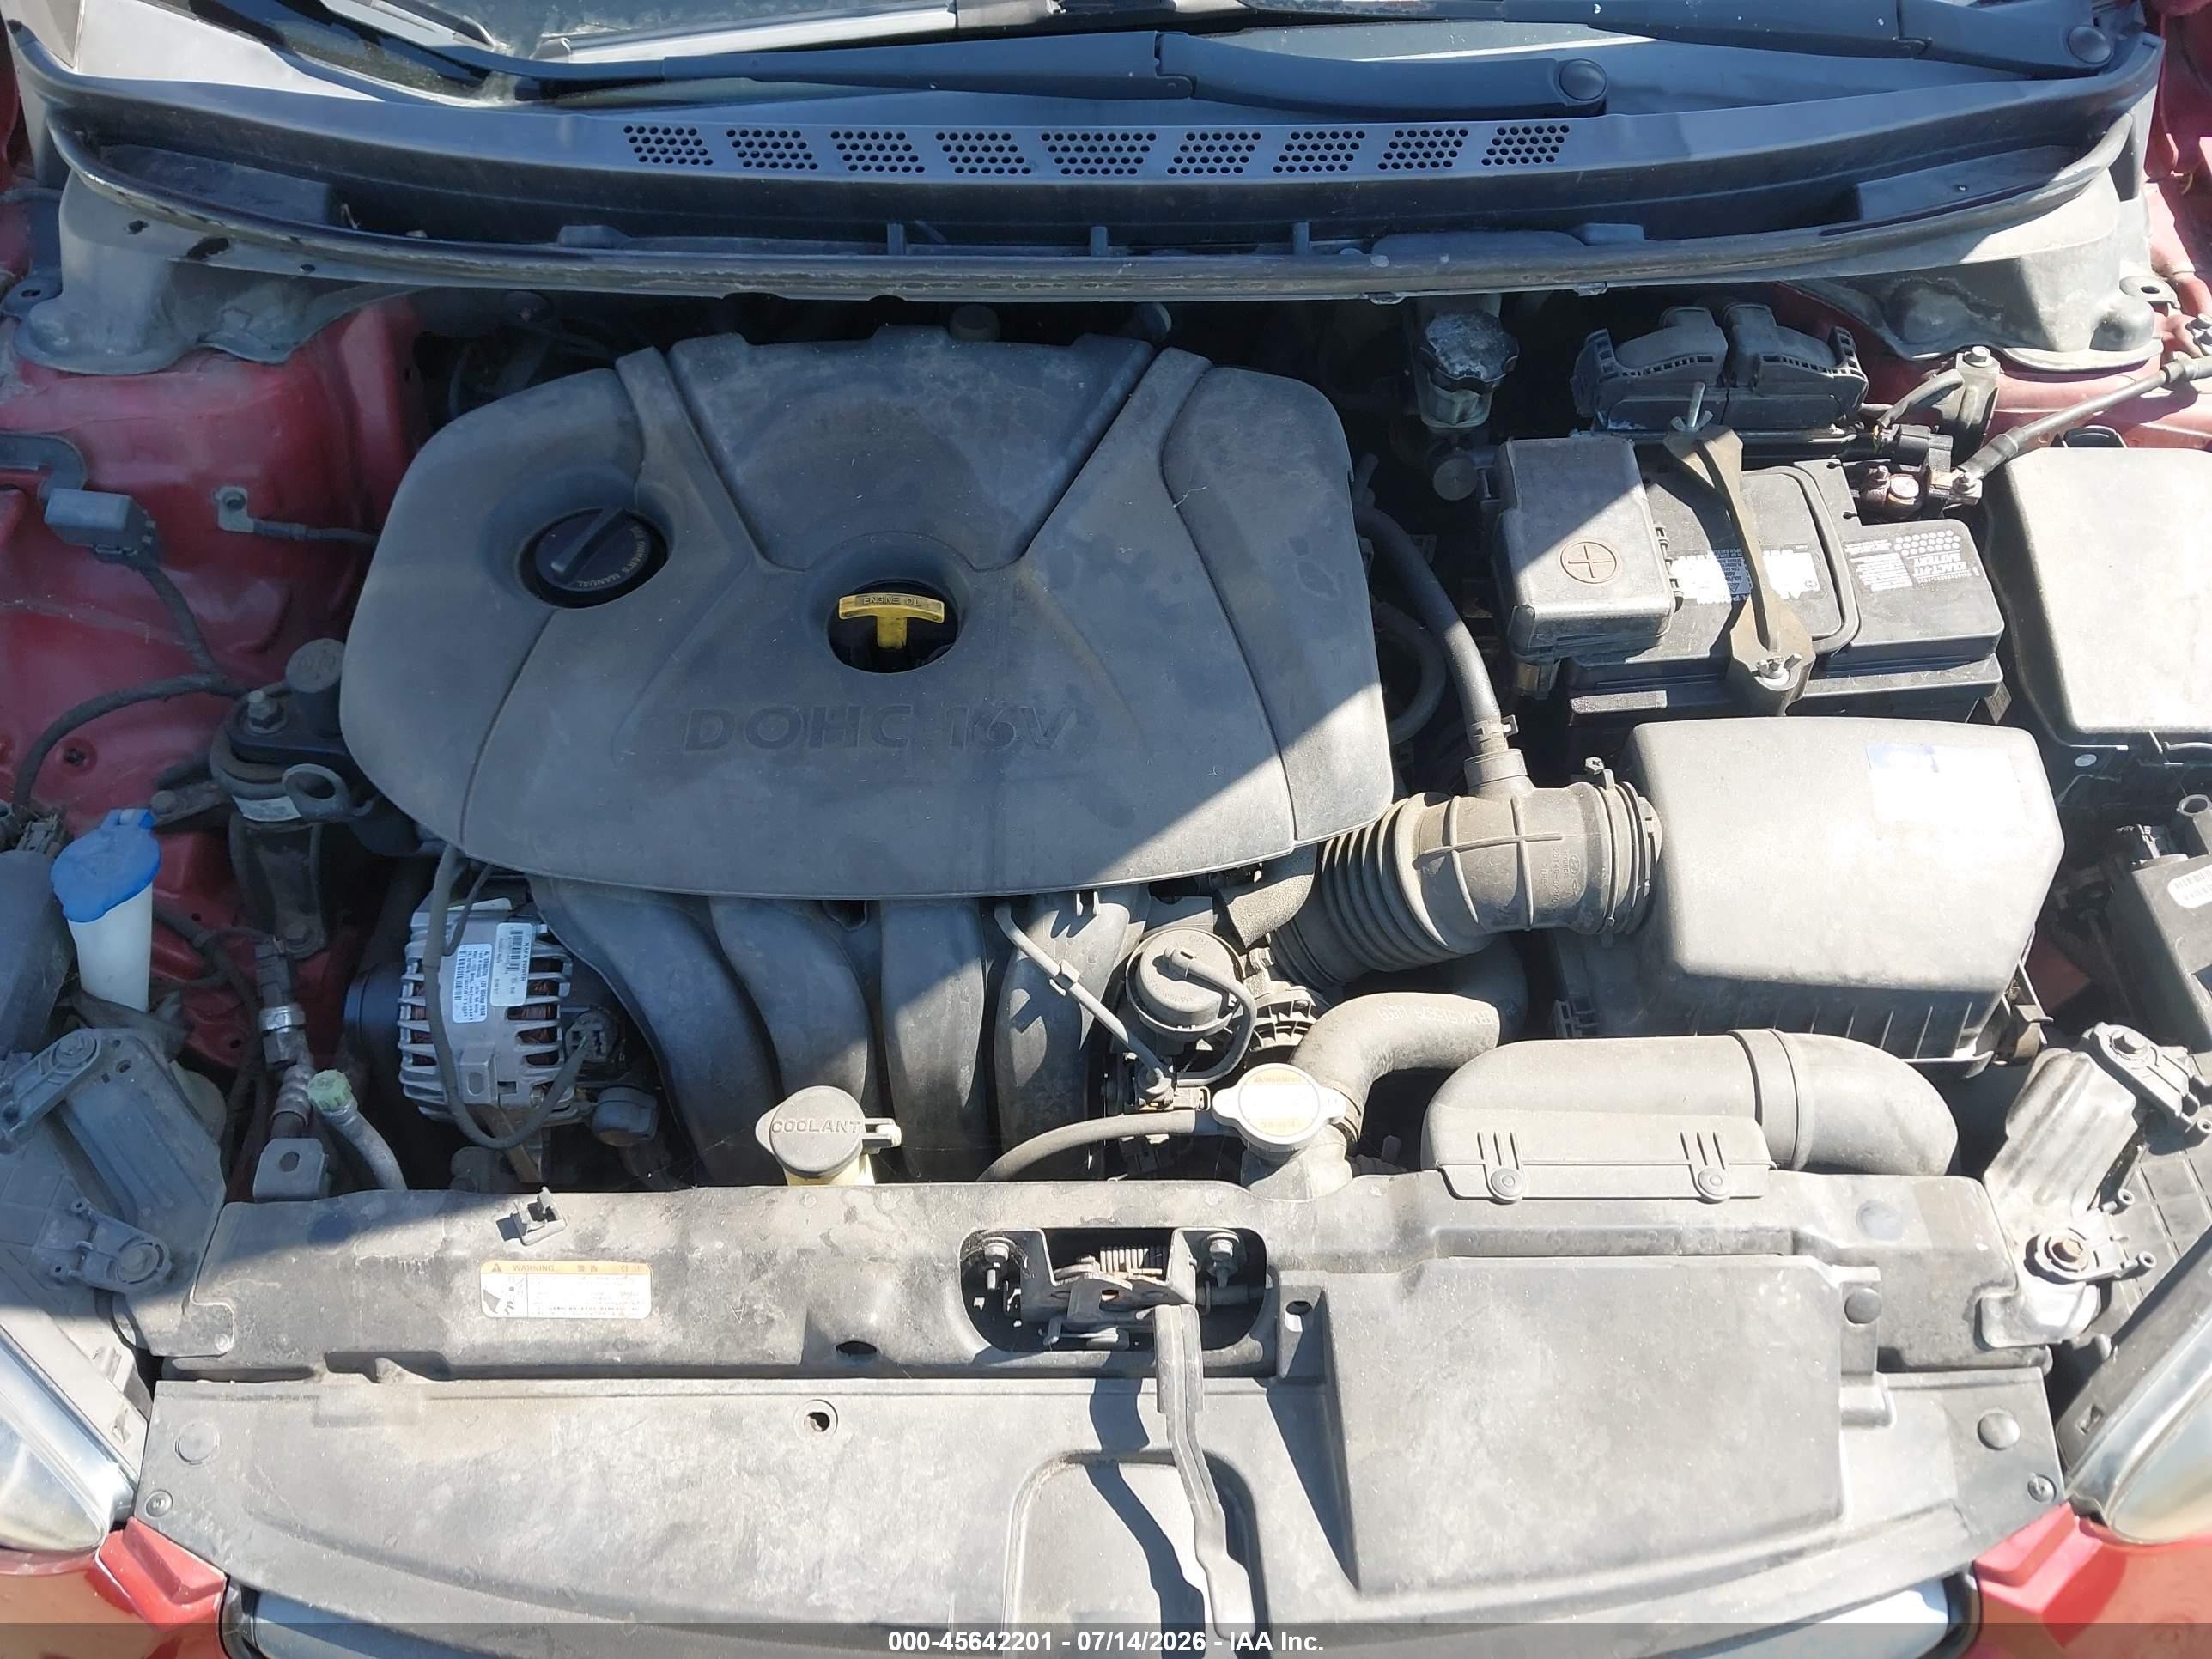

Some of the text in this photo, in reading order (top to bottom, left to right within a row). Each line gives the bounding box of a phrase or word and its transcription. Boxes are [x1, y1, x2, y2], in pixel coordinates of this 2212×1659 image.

[577, 573, 620, 588] MANUAL
[863, 596, 922, 607] ENGINE OIL
[684, 703, 1079, 751] DOHC 16V
[771, 1118, 861, 1134] COOLANT
